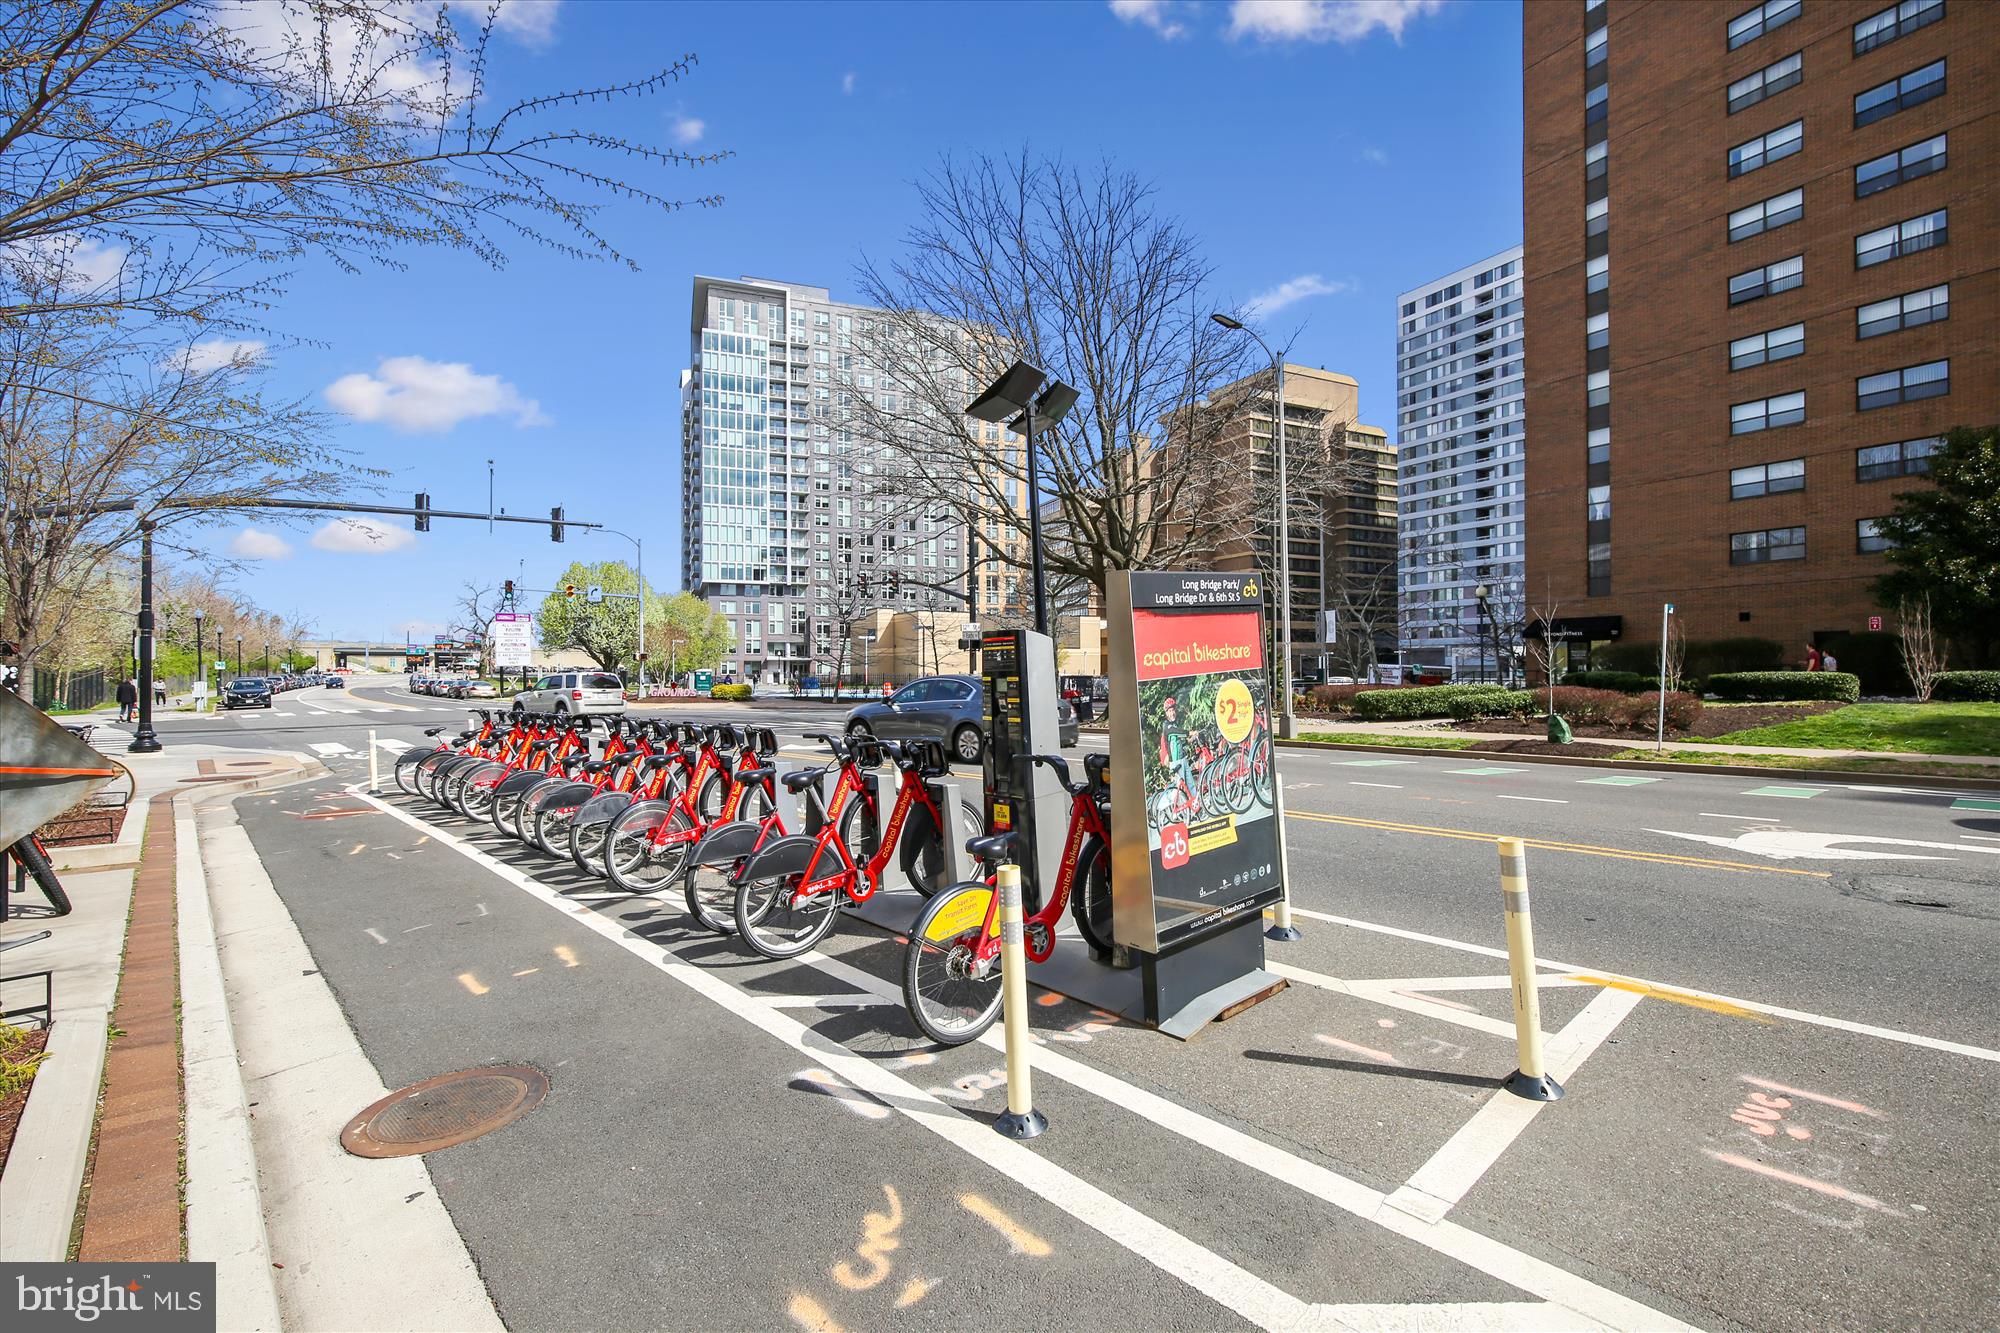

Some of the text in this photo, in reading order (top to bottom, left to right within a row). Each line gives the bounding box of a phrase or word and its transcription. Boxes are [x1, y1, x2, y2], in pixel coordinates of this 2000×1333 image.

[1155, 592, 1240, 605] Long Bridge Dr & 6th St S
[1181, 579, 1240, 591] Long Bridge Park/
[1144, 642, 1251, 670] capital bikeshare
[830, 779, 850, 813] bikeshare
[891, 787, 912, 826] bikeshare
[882, 827, 896, 858] capital
[1066, 816, 1085, 865] bikeshare
[1060, 868, 1073, 907] capital
